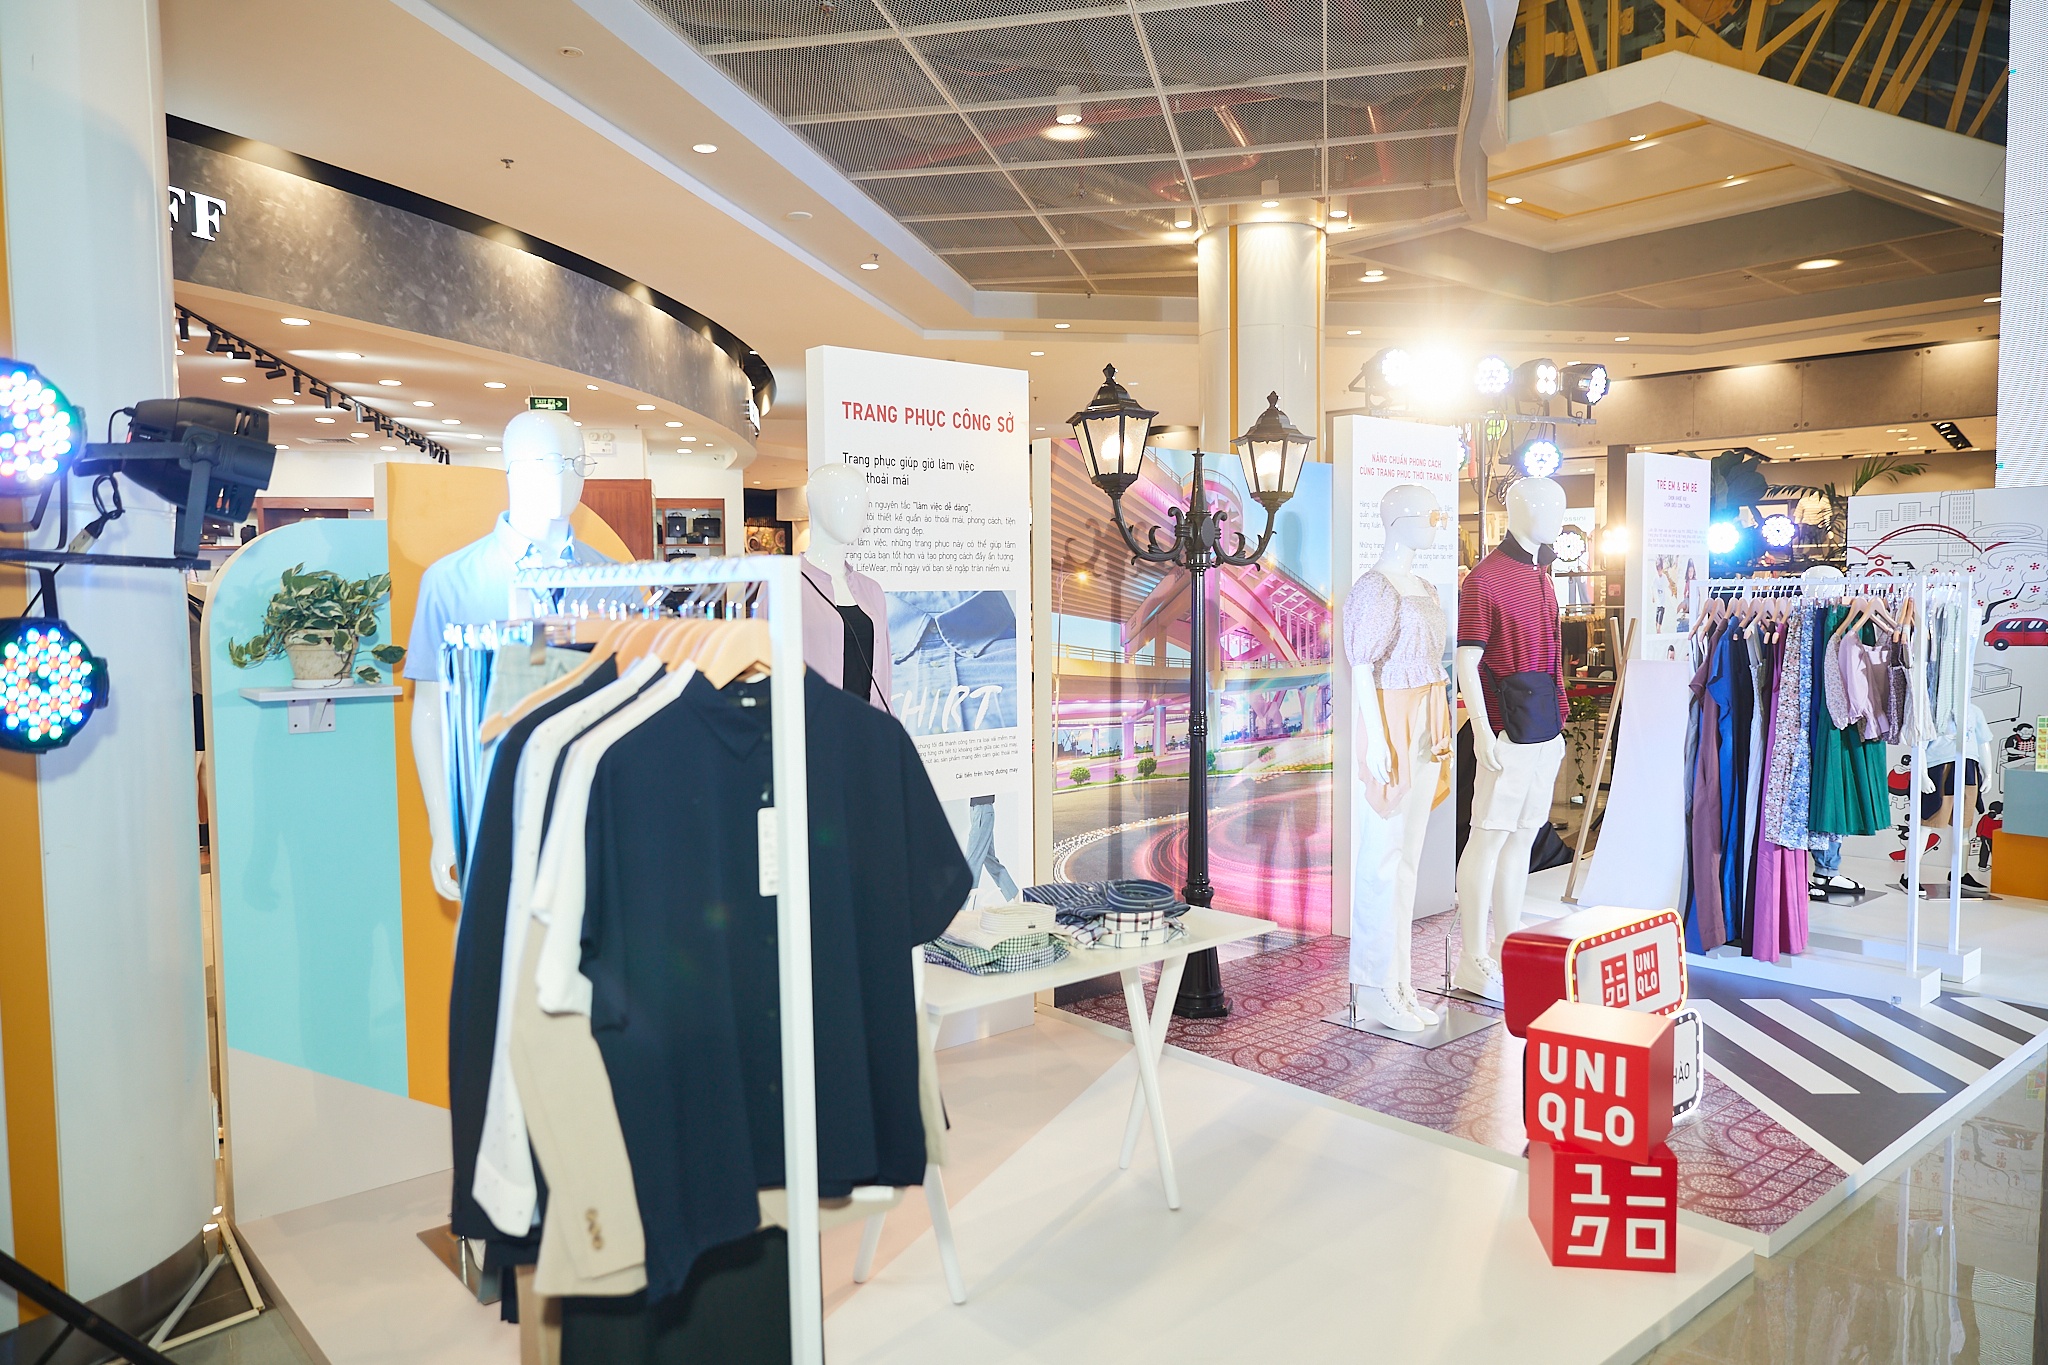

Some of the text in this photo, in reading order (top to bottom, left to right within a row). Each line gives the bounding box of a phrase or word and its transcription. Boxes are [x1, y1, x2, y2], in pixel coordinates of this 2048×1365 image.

[842, 401, 1014, 433] TRANG PHỤC CÔNG SỞ
[842, 452, 975, 474] Trang phục giúp giờ làm việc
[866, 472, 910, 486] thoải mái
[1635, 950, 1655, 972] UNI
[1636, 971, 1658, 997] QLO
[1539, 1042, 1626, 1098] UNI
[1673, 1061, 1690, 1084] HÀO
[1538, 1092, 1635, 1146] QLO
